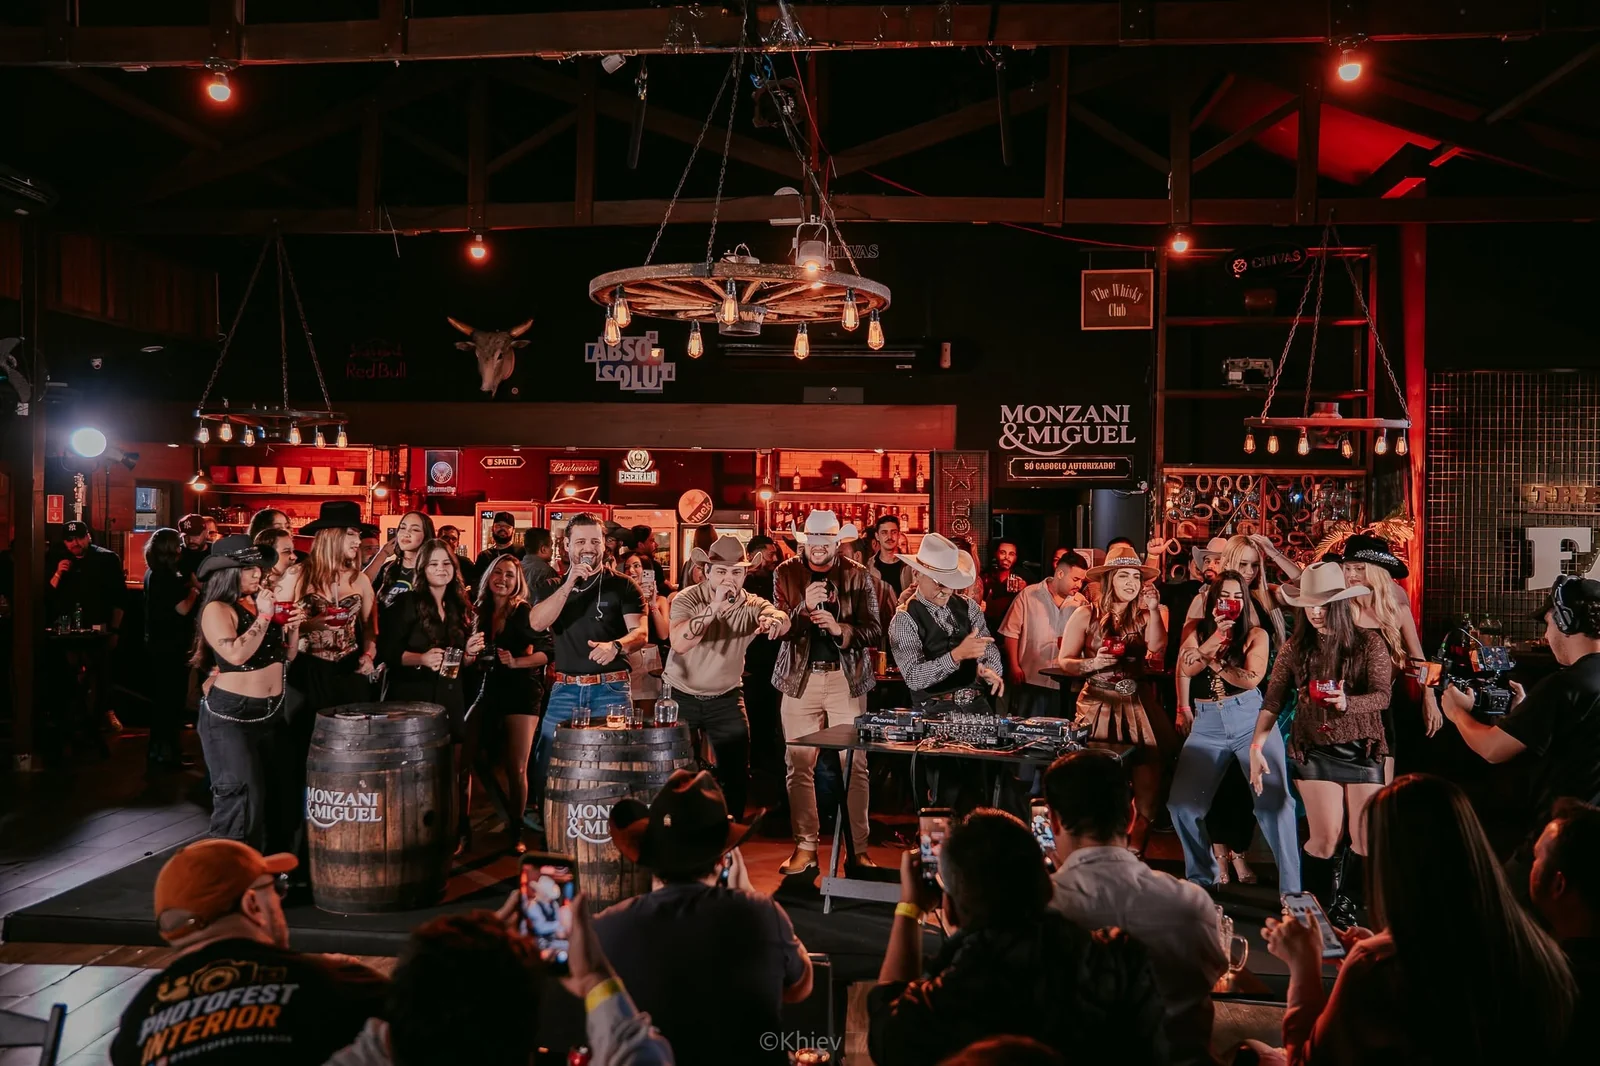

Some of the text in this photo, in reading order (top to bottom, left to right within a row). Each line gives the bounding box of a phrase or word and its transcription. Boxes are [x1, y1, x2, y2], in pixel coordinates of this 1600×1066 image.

[1251, 249, 1302, 269] CHIVAS
[1090, 283, 1144, 304] The Whisky
[1108, 302, 1127, 317] Club
[345, 360, 407, 380] Red Bull
[999, 404, 1131, 424] MONZANI
[493, 458, 517, 466] SPATEN
[550, 461, 598, 473] Budweiser
[1024, 461, 1034, 471] SÓ
[306, 786, 379, 807] MONZANI
[136, 983, 300, 1047] PHOTOFEST
[140, 1004, 282, 1066] INTERIOR
